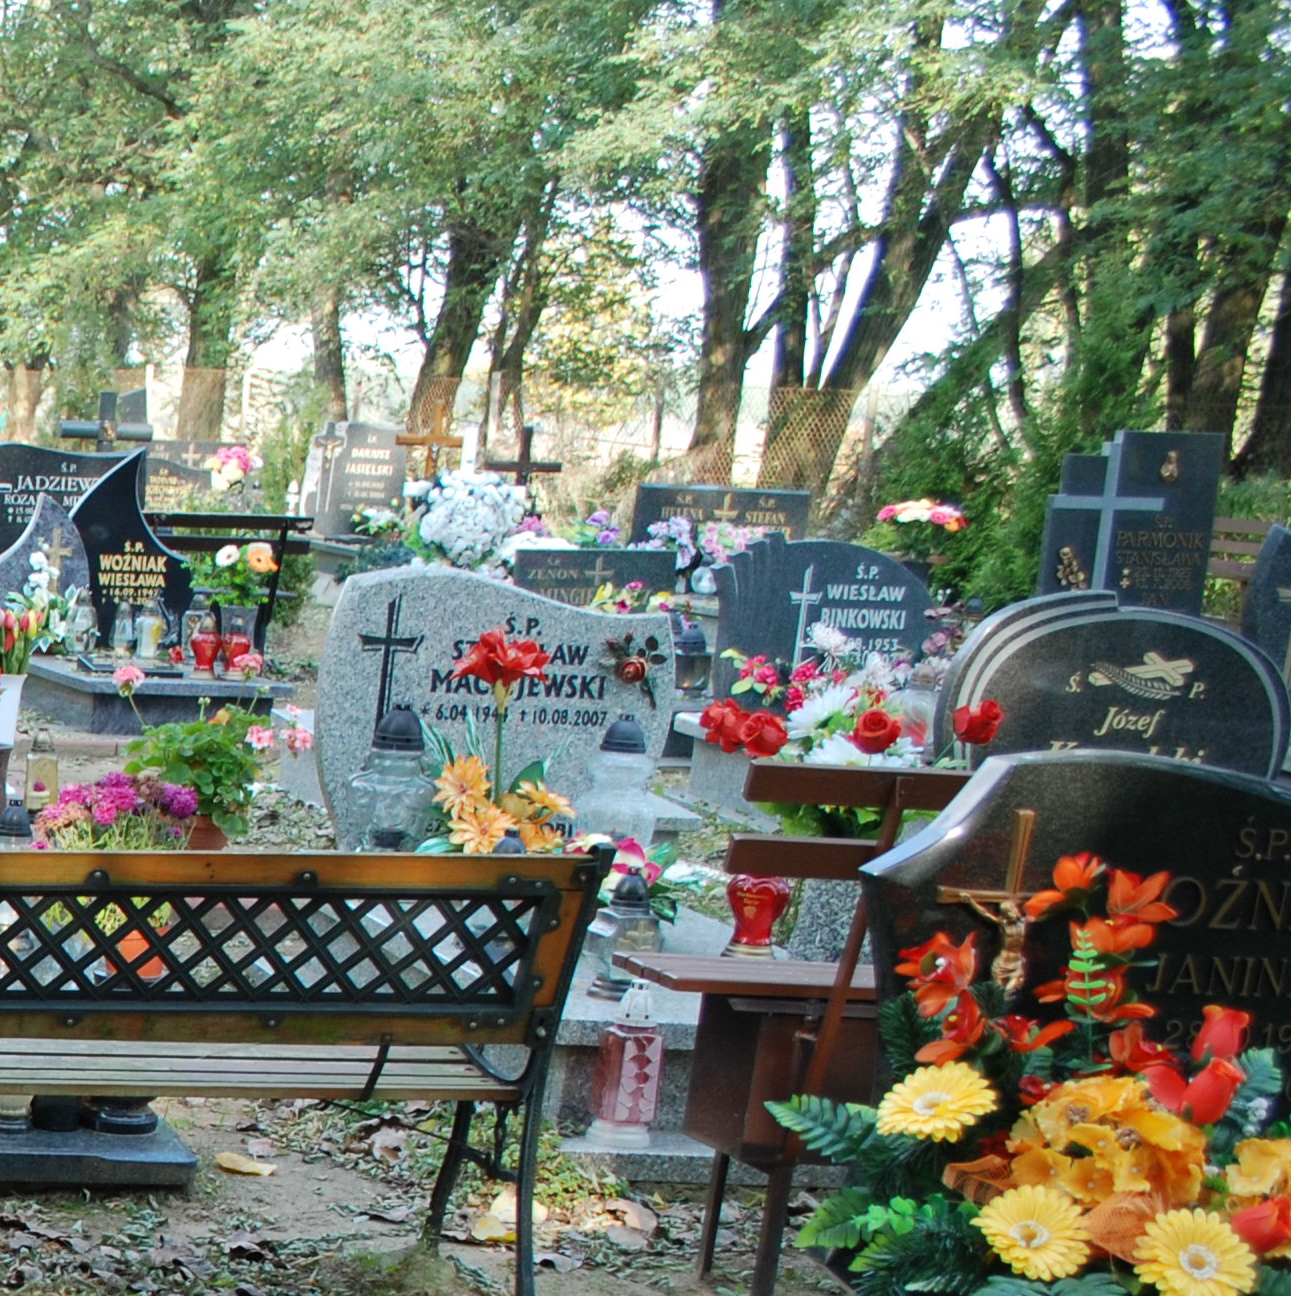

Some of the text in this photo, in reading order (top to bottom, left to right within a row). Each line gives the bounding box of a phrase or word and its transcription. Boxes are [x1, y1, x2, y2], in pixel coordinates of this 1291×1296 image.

[1116, 530, 1204, 549] PARMONIK
[99, 554, 168, 572] WOŹNIAK
[827, 583, 907, 602] WIESŁAW
[820, 607, 907, 631] BINKOWSKI
[429, 668, 608, 702] MACJEWSKI
[1093, 706, 1167, 739] Józef
